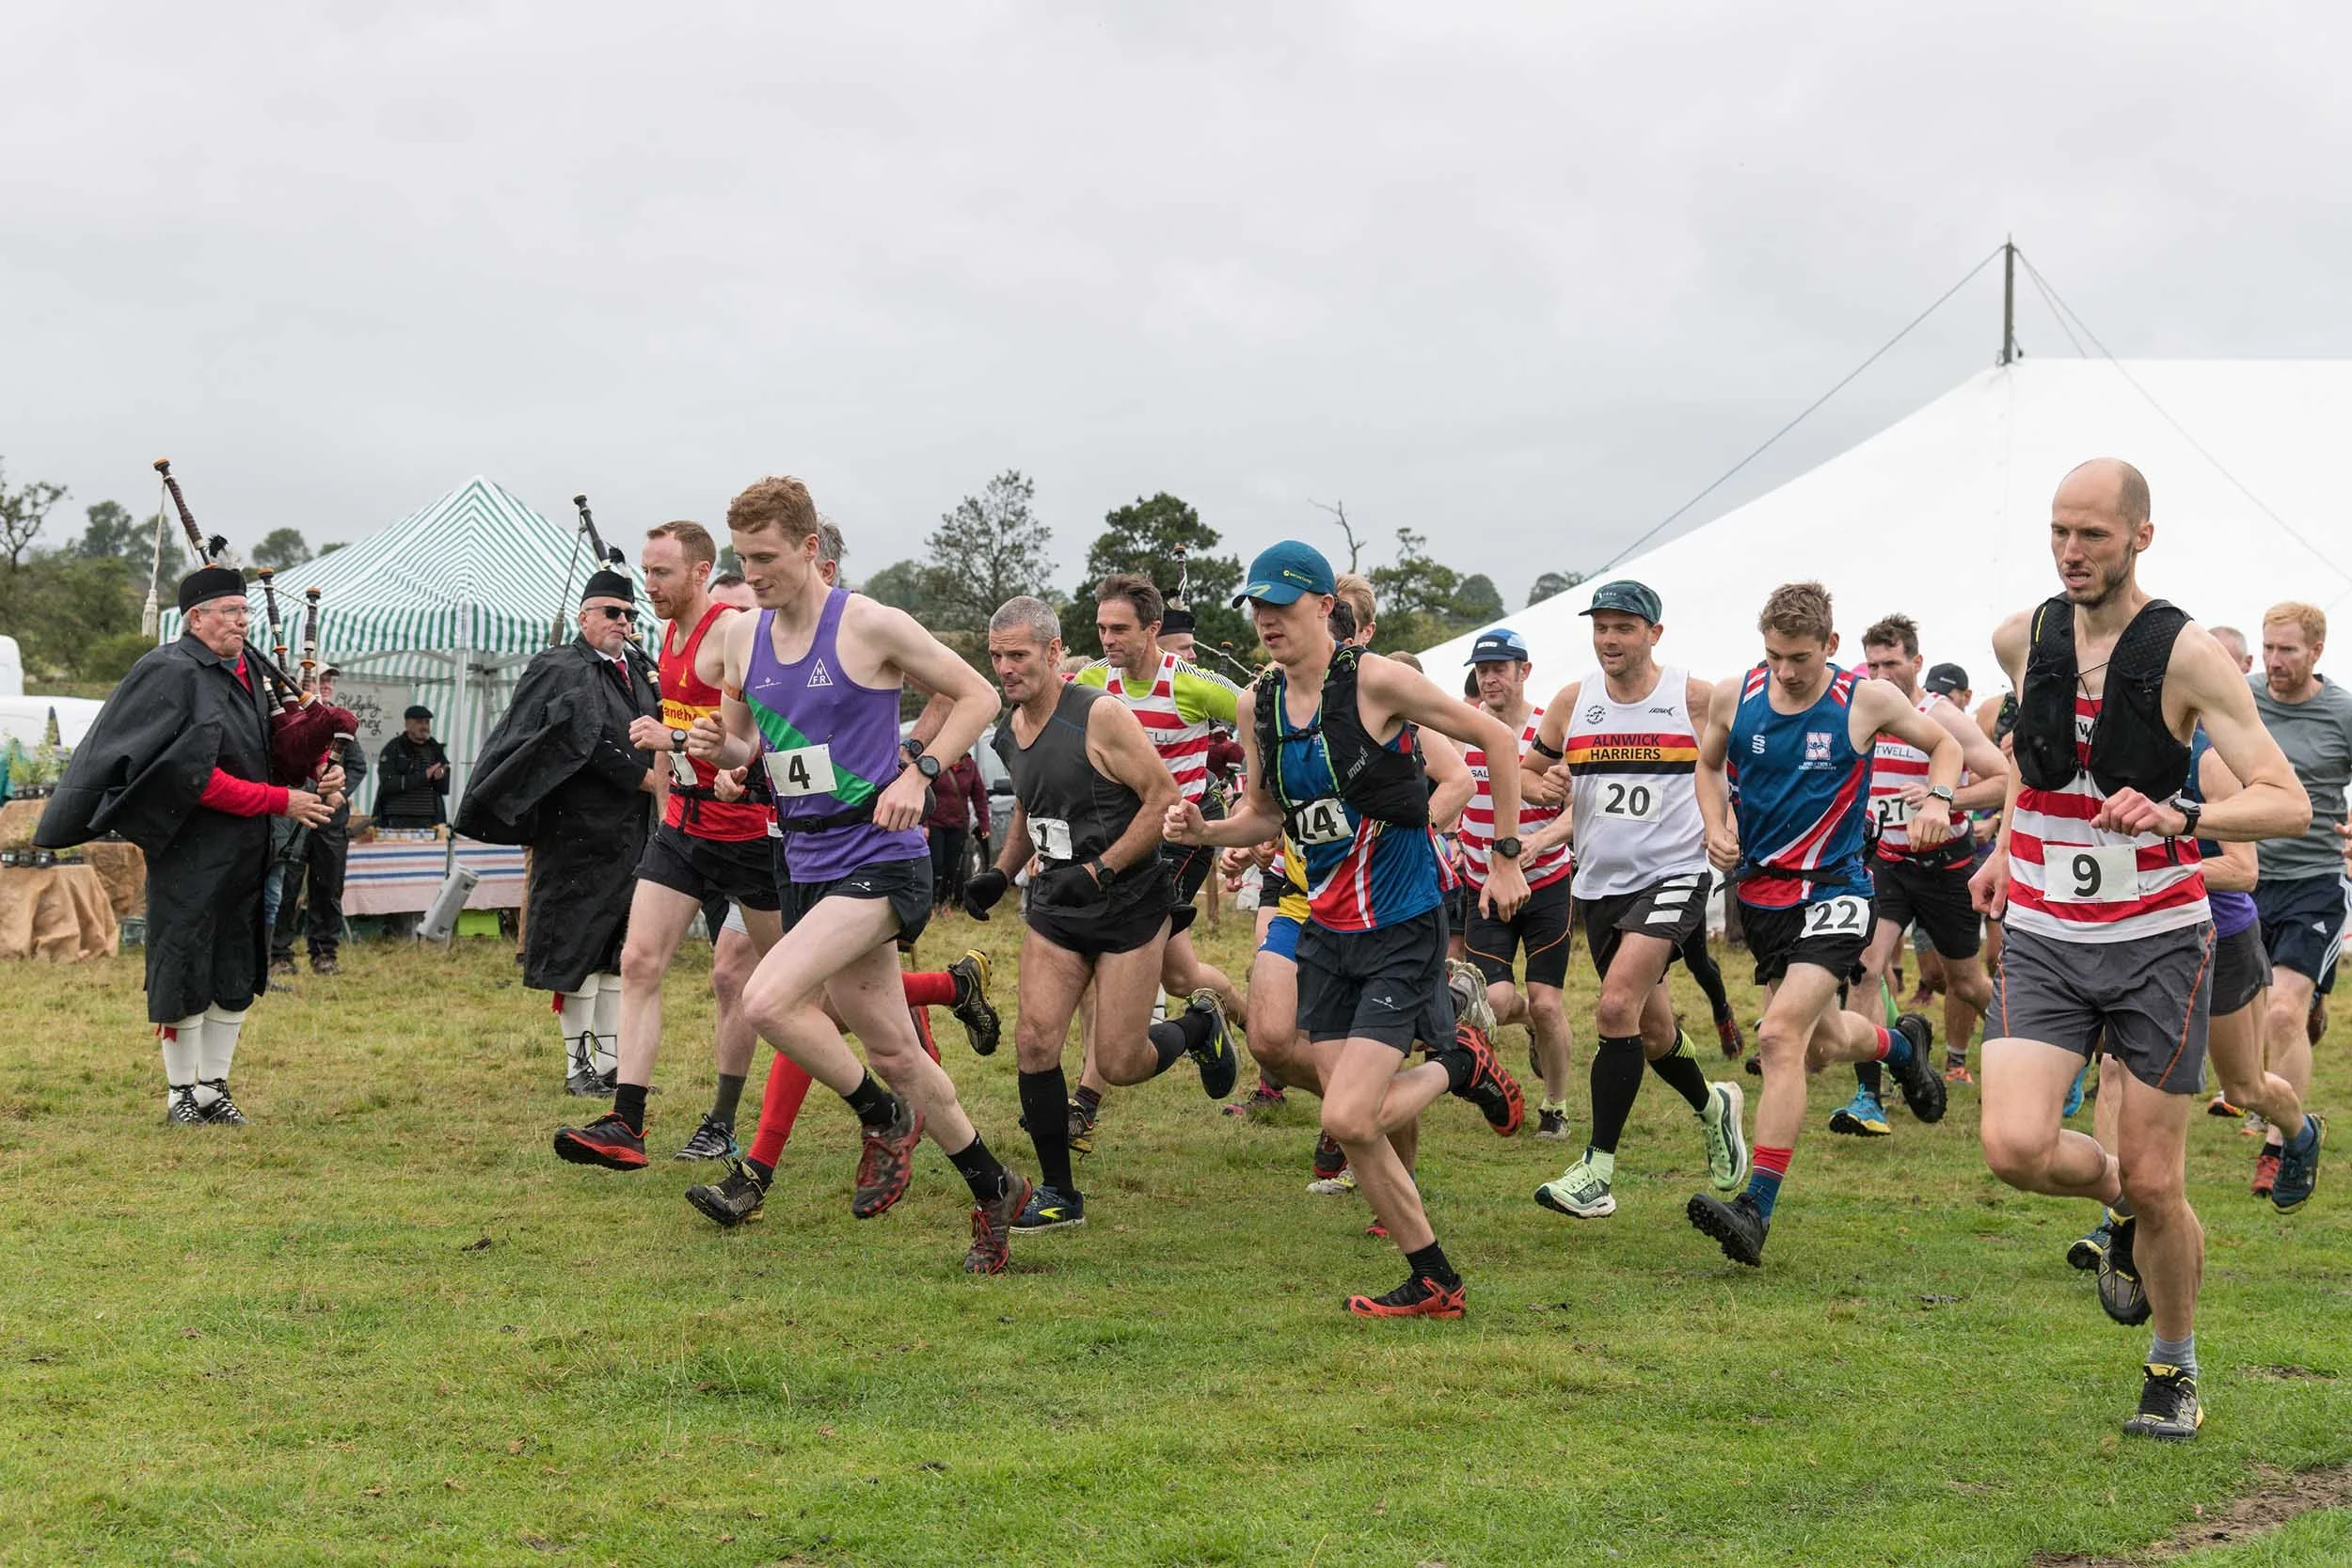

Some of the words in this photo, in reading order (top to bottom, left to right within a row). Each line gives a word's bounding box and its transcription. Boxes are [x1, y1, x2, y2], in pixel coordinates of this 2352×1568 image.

[1590, 748, 1661, 761] HARRIERS
[1592, 734, 1661, 747] ALNWICK
[1876, 744, 1914, 759] TWELL
[788, 754, 811, 790] 4
[1604, 783, 1651, 817] 20
[1877, 797, 1906, 822] 27
[1036, 822, 1051, 853] 1
[2072, 853, 2102, 897] 9
[1811, 899, 1860, 932] 22
